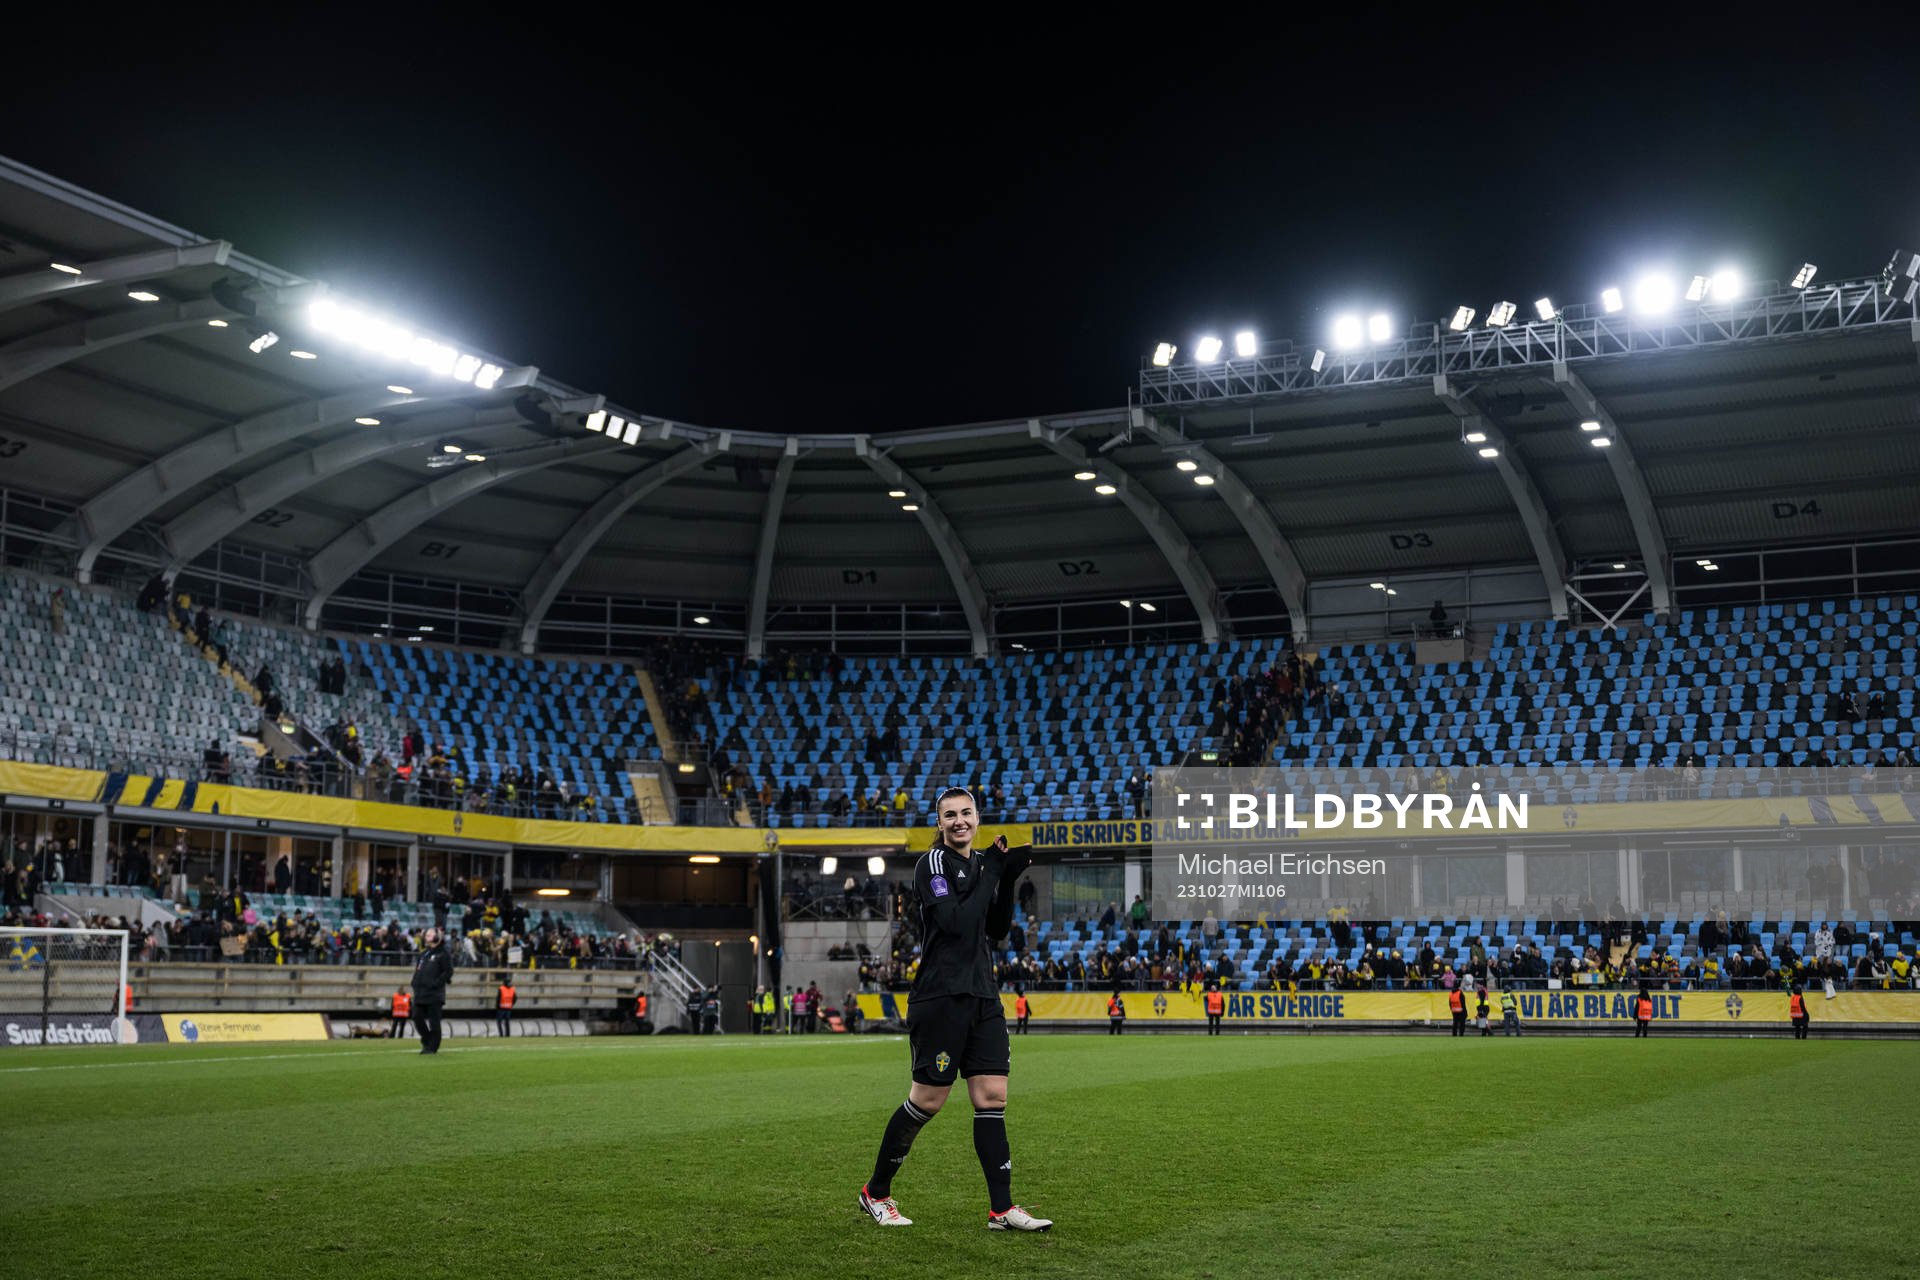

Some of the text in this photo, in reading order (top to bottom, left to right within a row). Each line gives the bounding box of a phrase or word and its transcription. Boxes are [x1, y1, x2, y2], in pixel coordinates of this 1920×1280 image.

[251, 509, 294, 528] B2
[1772, 500, 1821, 519] D4
[420, 541, 461, 559] B1
[1389, 532, 1434, 551] D3
[842, 569, 878, 585] D1
[1058, 560, 1100, 576] D2
[1032, 823, 1068, 846] HÄR
[1071, 821, 1137, 845] SKRIVS
[1228, 994, 1255, 1017] ÄR
[1260, 995, 1344, 1018] SVERIGE
[1520, 994, 1543, 1017] VI
[1549, 993, 1579, 1018] ÄR
[6, 1023, 114, 1044] Sundström
